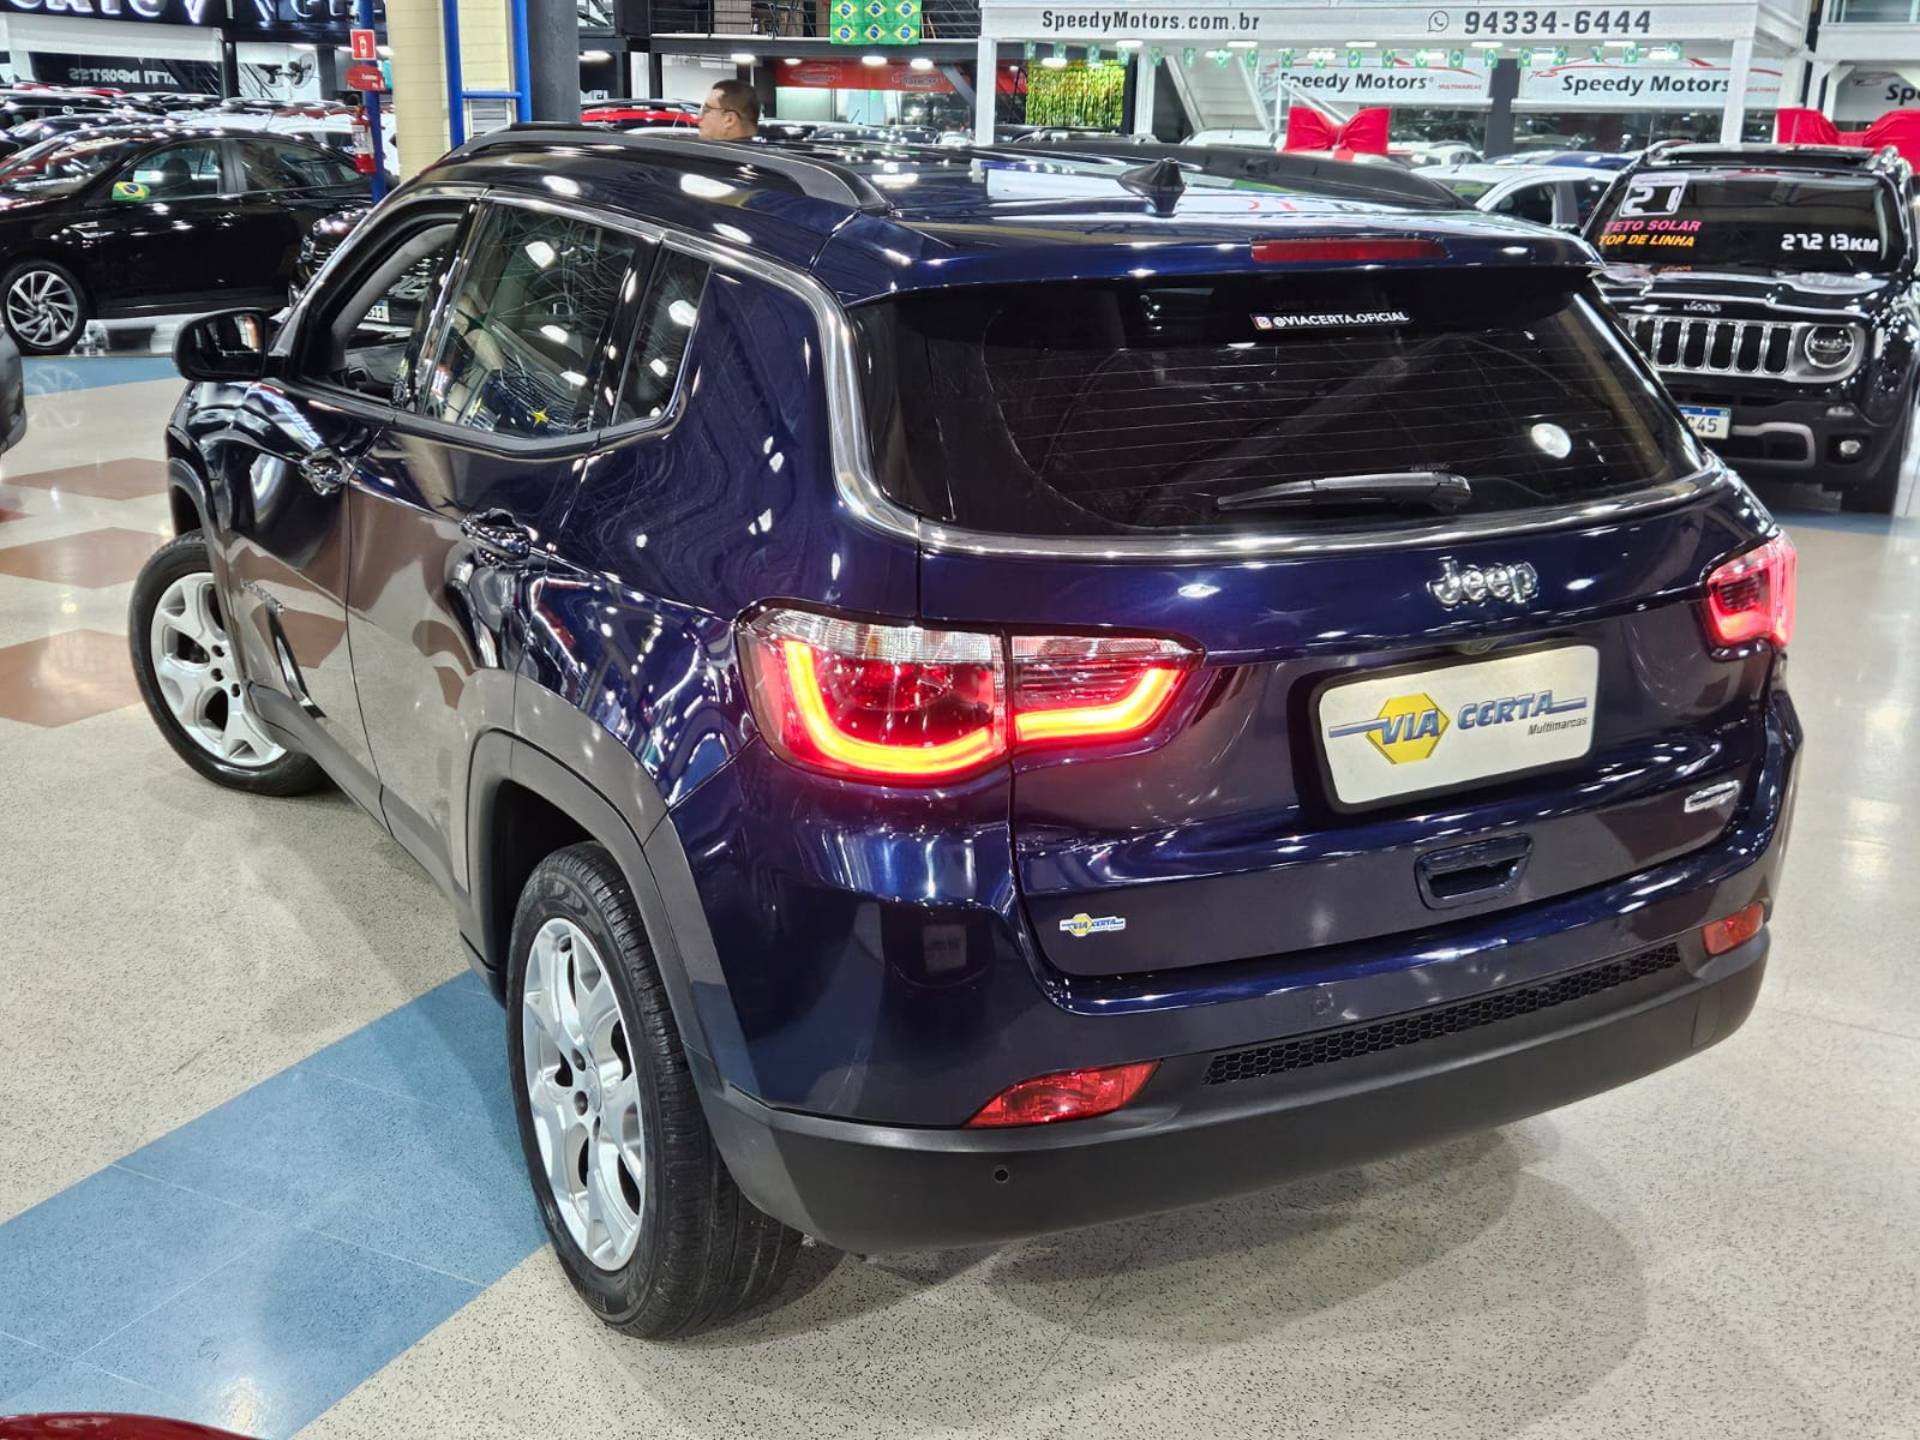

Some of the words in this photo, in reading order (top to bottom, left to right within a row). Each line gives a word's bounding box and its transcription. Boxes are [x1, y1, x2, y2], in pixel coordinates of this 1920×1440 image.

[1042, 10, 1260, 32] SpeedyMotors.com.br
[1464, 10, 1651, 34] 94334-6444
[1355, 73, 1427, 90] Motors
[1562, 75, 1643, 96] Speedy
[1885, 84, 1920, 106] Sp
[1624, 186, 1681, 214] 21
[1604, 220, 1645, 232] TETO
[1647, 220, 1702, 232] SOLAR
[1599, 234, 1627, 247] TOP
[1627, 234, 1649, 246] DE
[1649, 235, 1695, 247] LINHA
[1273, 311, 1410, 327] @VIACERTA.OFICIAL
[1428, 556, 1538, 610] Jeep
[1379, 708, 1441, 745] VIA
[1458, 690, 1553, 730] CERTA
[1528, 717, 1587, 735] Multimarcas
